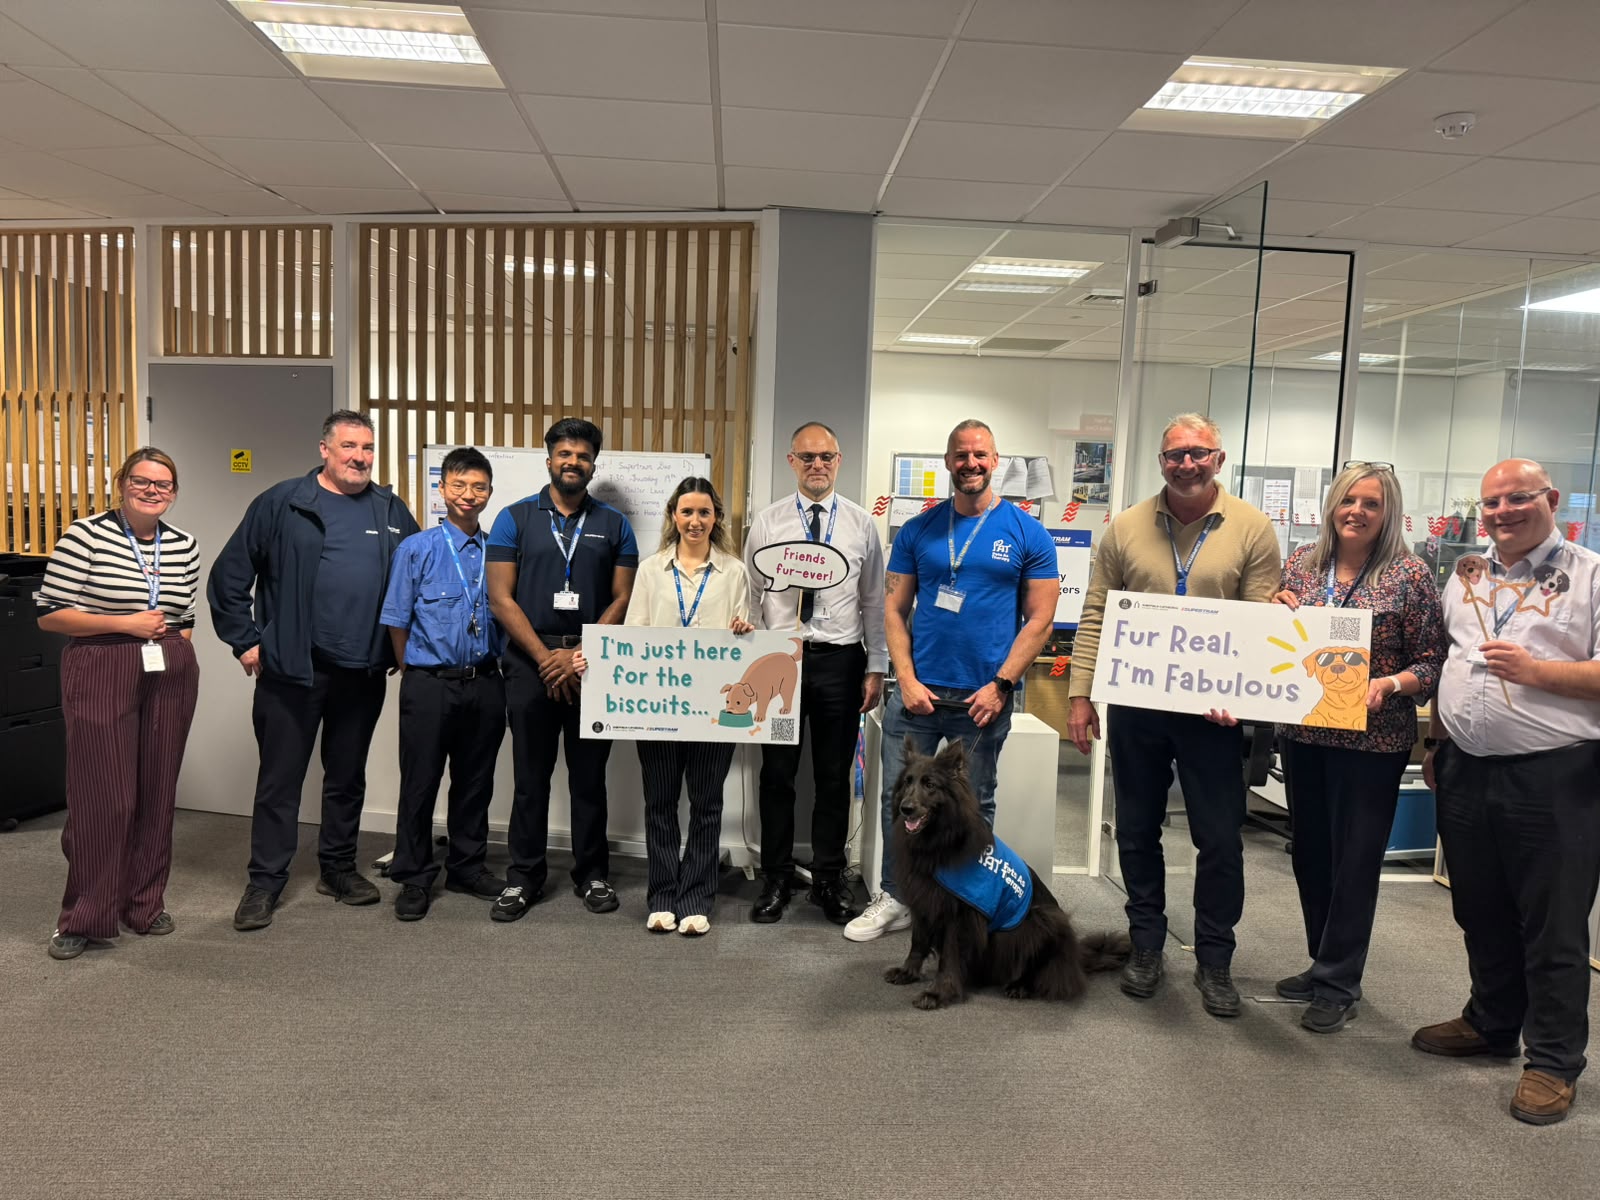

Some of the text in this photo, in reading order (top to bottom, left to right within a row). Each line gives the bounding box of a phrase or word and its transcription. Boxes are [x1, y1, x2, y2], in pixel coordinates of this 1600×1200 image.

[784, 547, 826, 565] Friends
[776, 563, 833, 583] fur-ever!
[601, 636, 742, 661] I'm just here
[1114, 620, 1239, 657] Fur Real,
[612, 664, 693, 688] for the
[1107, 658, 1300, 703] I'm Fabulous
[606, 693, 709, 716] biscuits...
